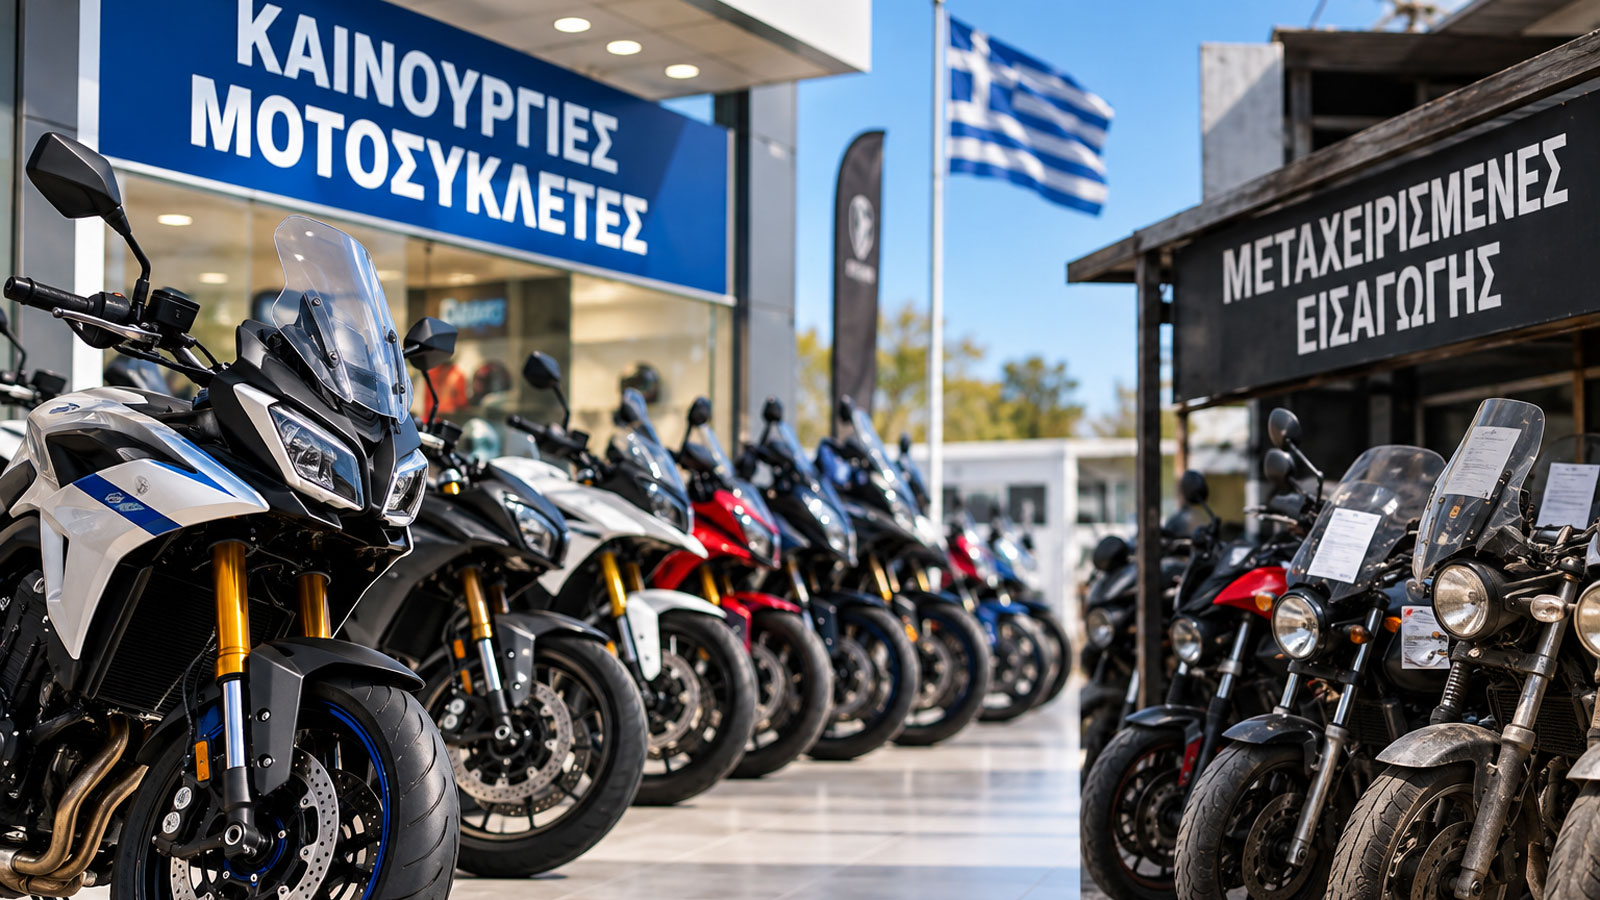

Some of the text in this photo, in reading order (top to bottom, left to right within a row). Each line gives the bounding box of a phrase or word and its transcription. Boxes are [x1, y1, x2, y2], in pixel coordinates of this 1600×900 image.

[190, 73, 648, 256] ΜΟΤΟΣΥΚΛΕΤΕΣ
[237, 0, 619, 174] ΚΑΙΝΟΥΡΓΙΕΣ
[1223, 132, 1569, 304] ΜΕΤΑΧΕΙΡΙΣΜΕΝΕΣ
[1297, 241, 1502, 355] ΕΙΣΑΓΩΓΗΣ
